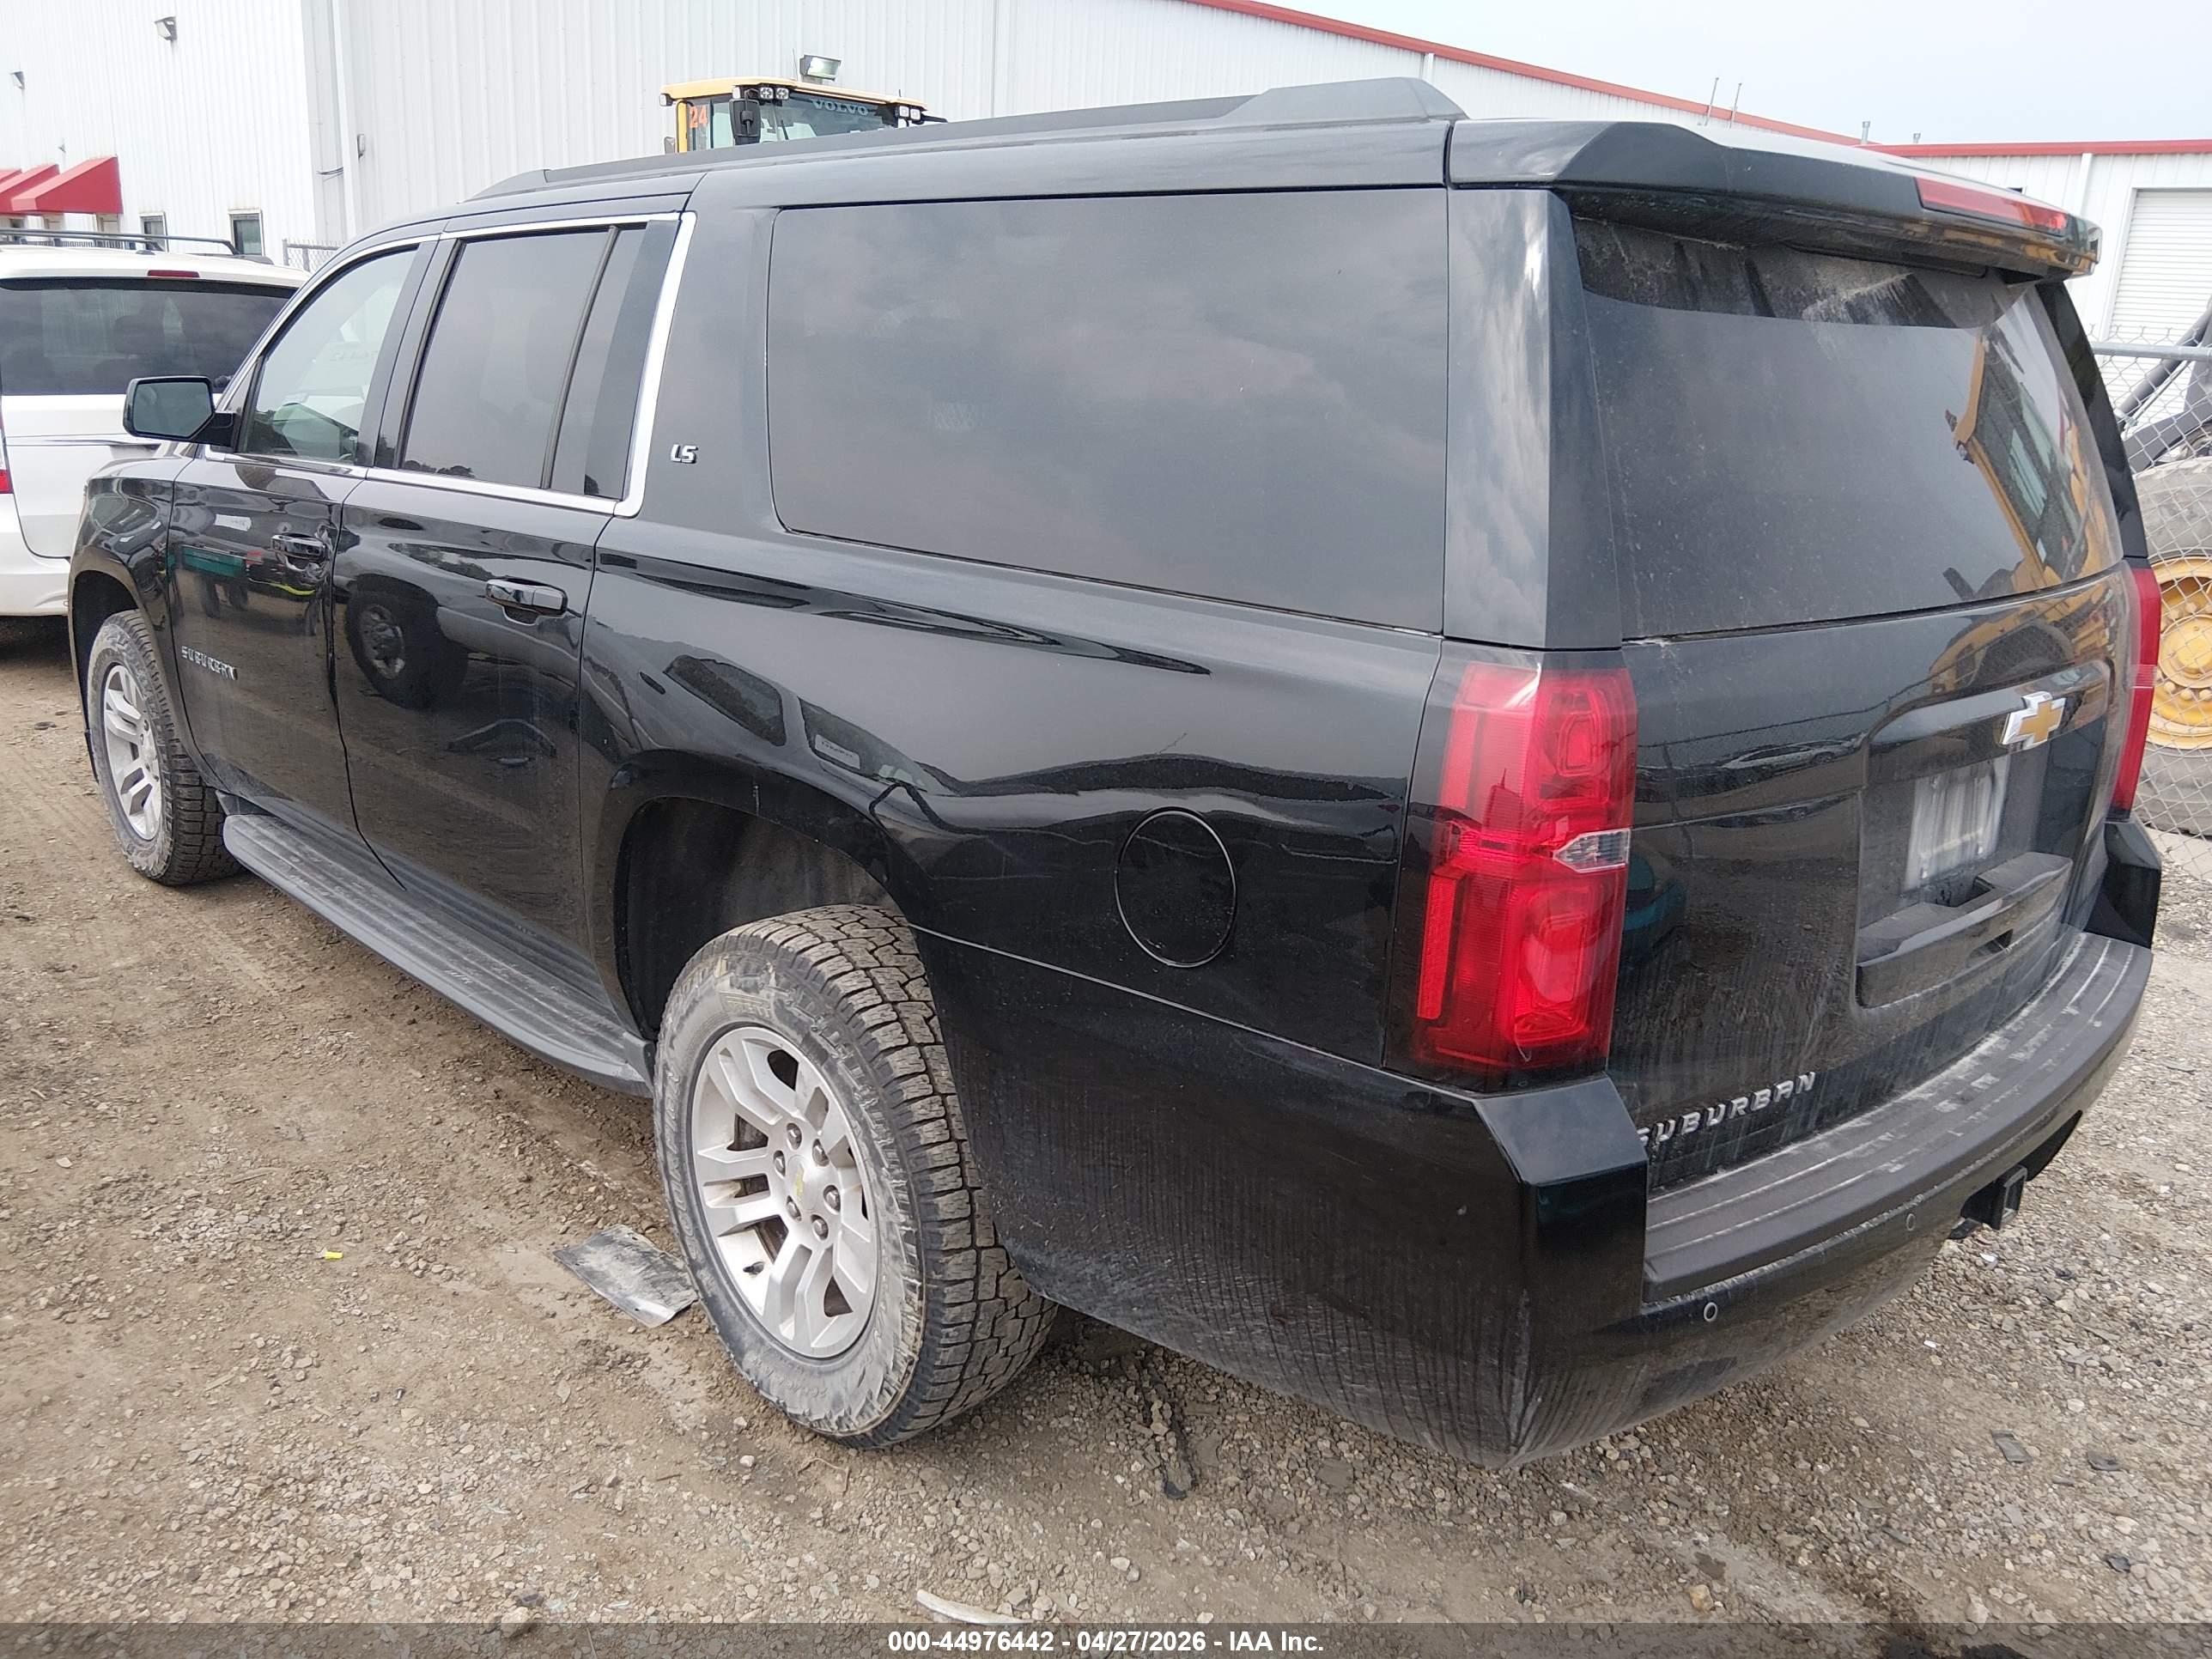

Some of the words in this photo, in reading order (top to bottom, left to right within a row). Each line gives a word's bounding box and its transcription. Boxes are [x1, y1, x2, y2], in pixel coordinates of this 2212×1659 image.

[690, 106, 708, 128] 24
[810, 99, 869, 116] VOLVO
[670, 444, 697, 464] LS
